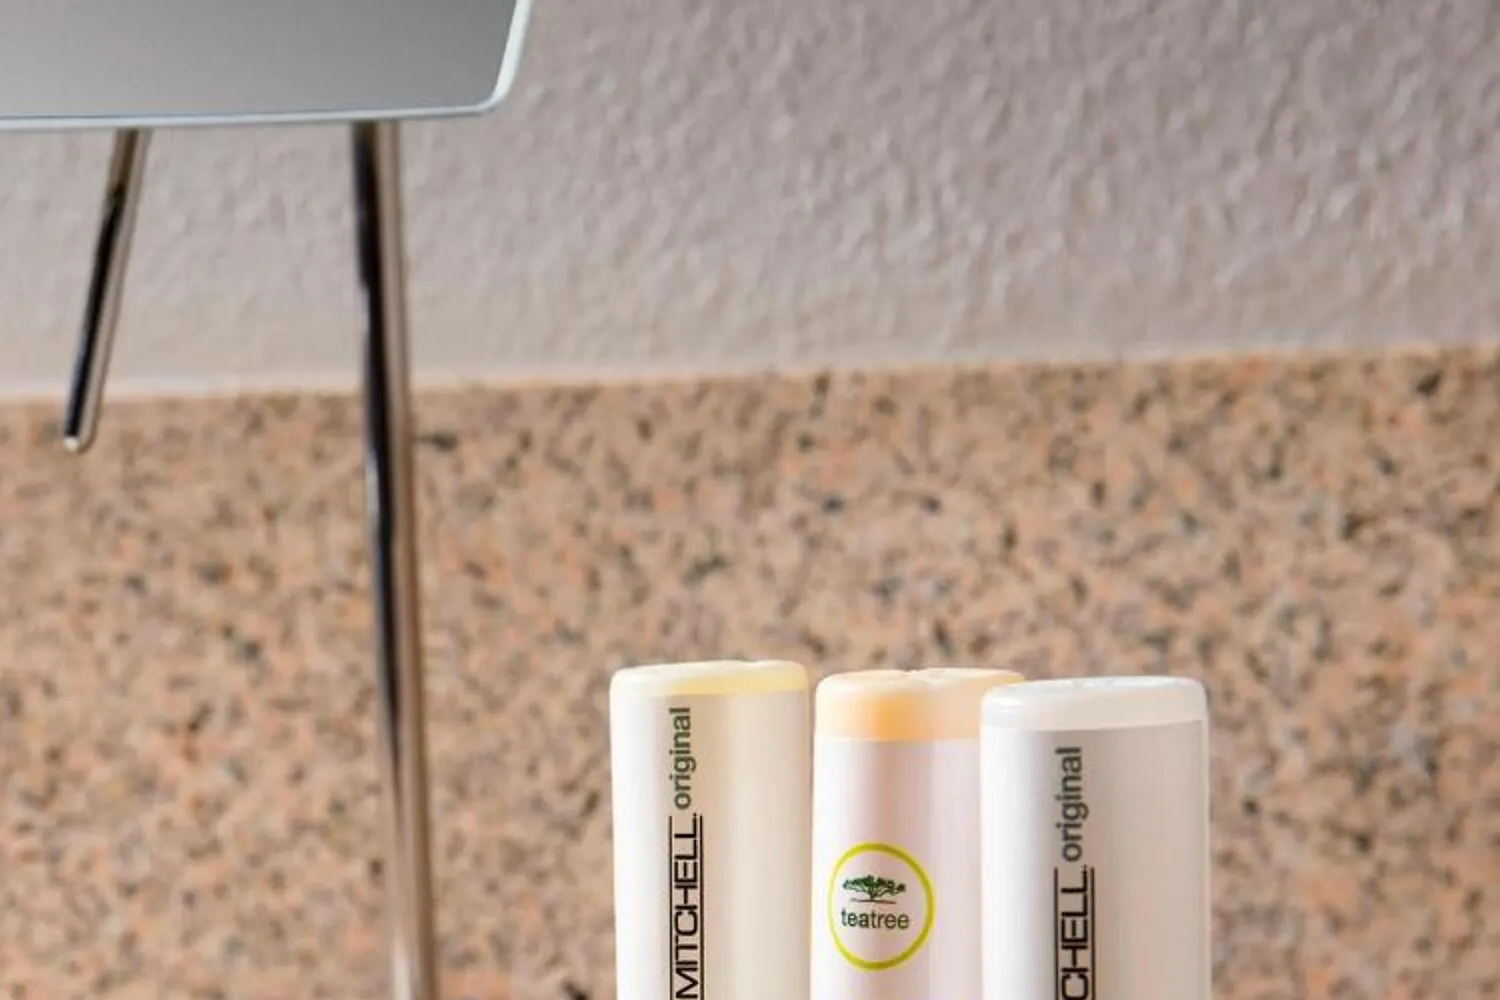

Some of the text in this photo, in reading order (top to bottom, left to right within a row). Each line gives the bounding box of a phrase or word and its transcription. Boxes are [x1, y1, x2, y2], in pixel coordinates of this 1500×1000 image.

[669, 707, 696, 810] original
[1055, 746, 1088, 862] original
[674, 815, 699, 1000] MITCHELL
[840, 907, 909, 930] teatree
